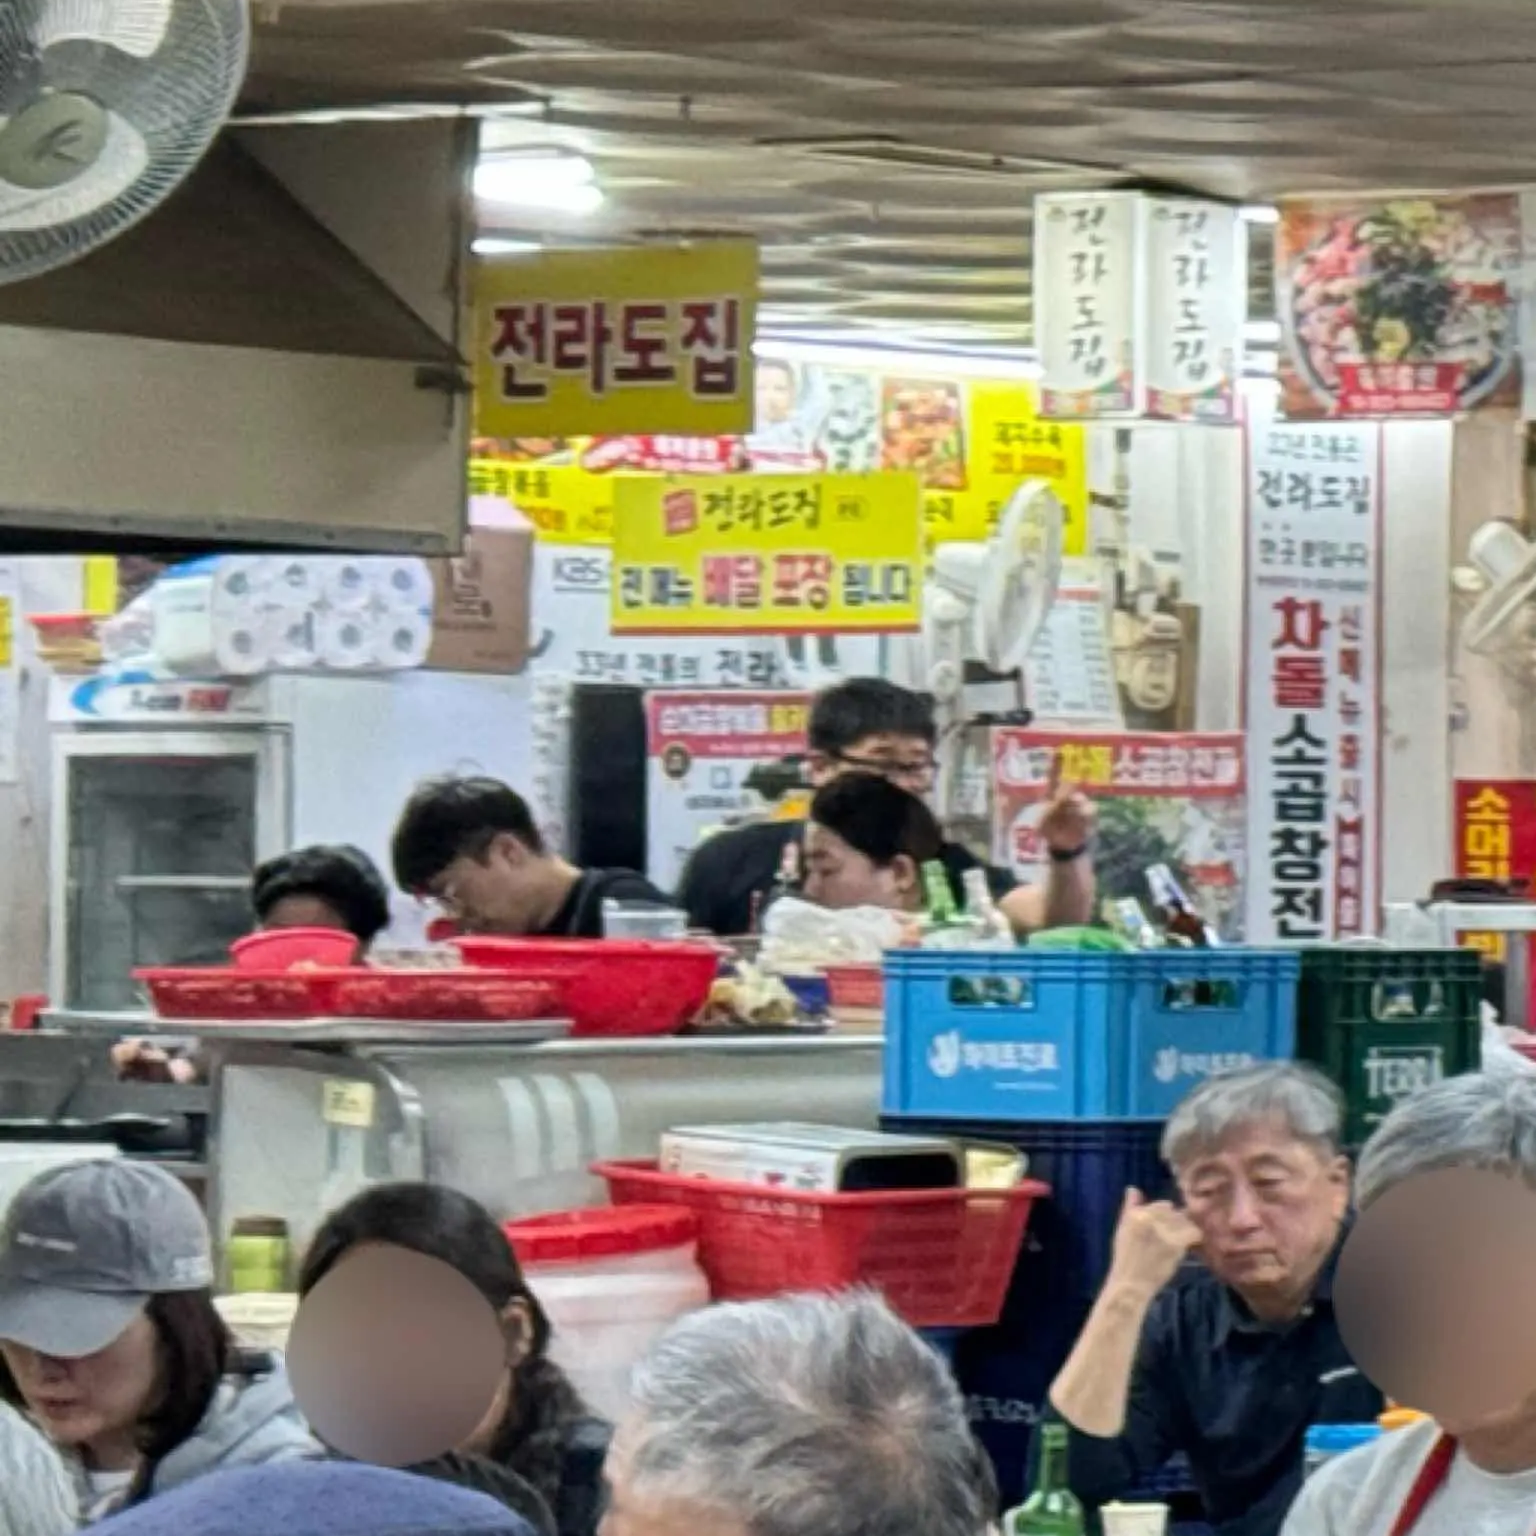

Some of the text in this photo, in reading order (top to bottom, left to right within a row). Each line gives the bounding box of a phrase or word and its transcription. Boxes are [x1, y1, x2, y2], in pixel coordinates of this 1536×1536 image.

[1069, 205, 1108, 377] 전라도집
[490, 299, 740, 397] 전라도집
[1256, 469, 1370, 515] 전라도집
[772, 554, 832, 610] 포장
[715, 649, 790, 688] 전라
